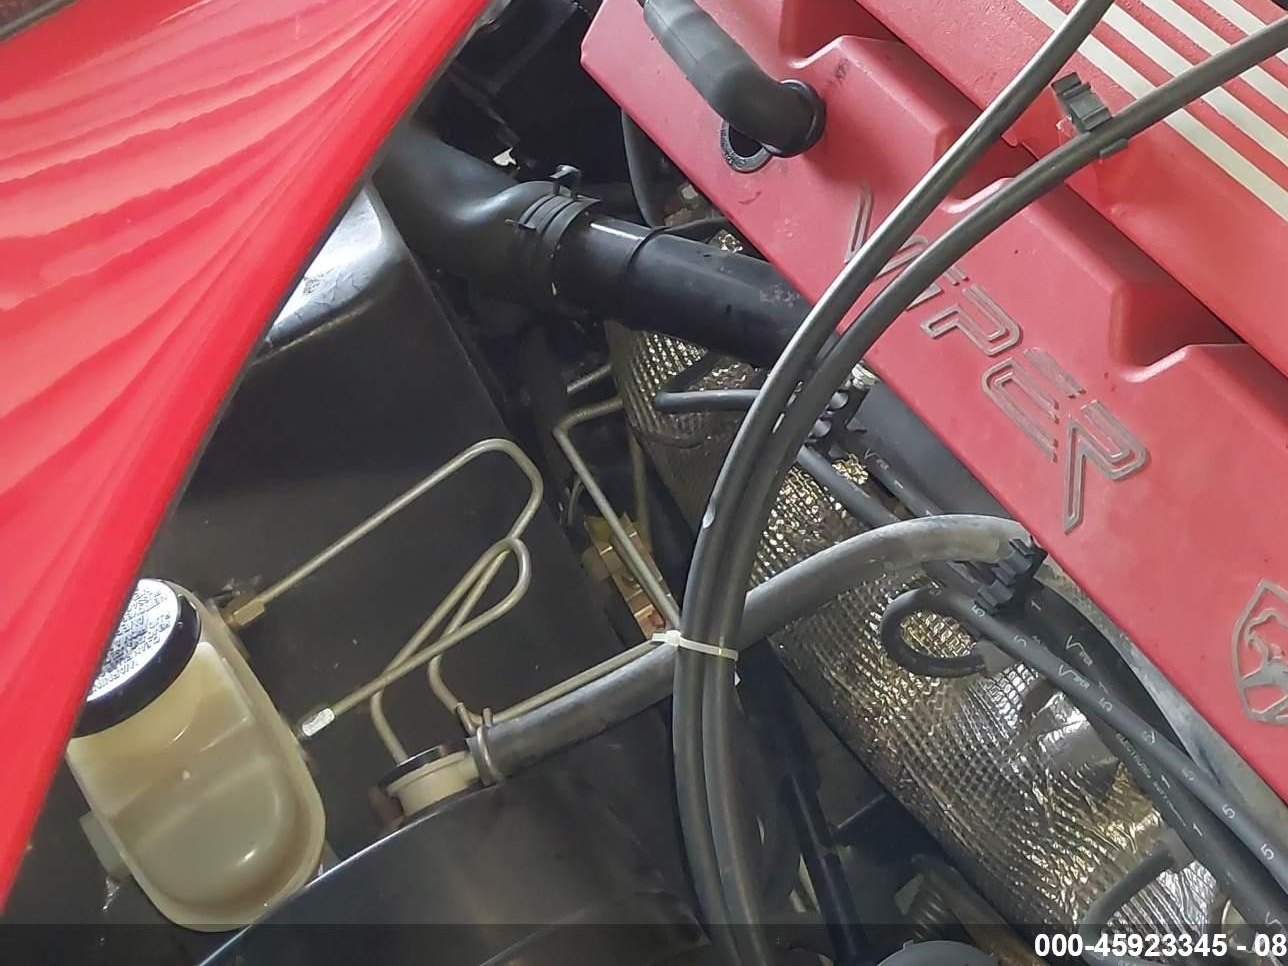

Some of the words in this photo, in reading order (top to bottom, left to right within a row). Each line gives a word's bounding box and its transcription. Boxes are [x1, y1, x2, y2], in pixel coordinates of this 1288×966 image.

[971, 604, 986, 618] 5
[1221, 803, 1237, 820] 5
[1259, 842, 1276, 861] 5
